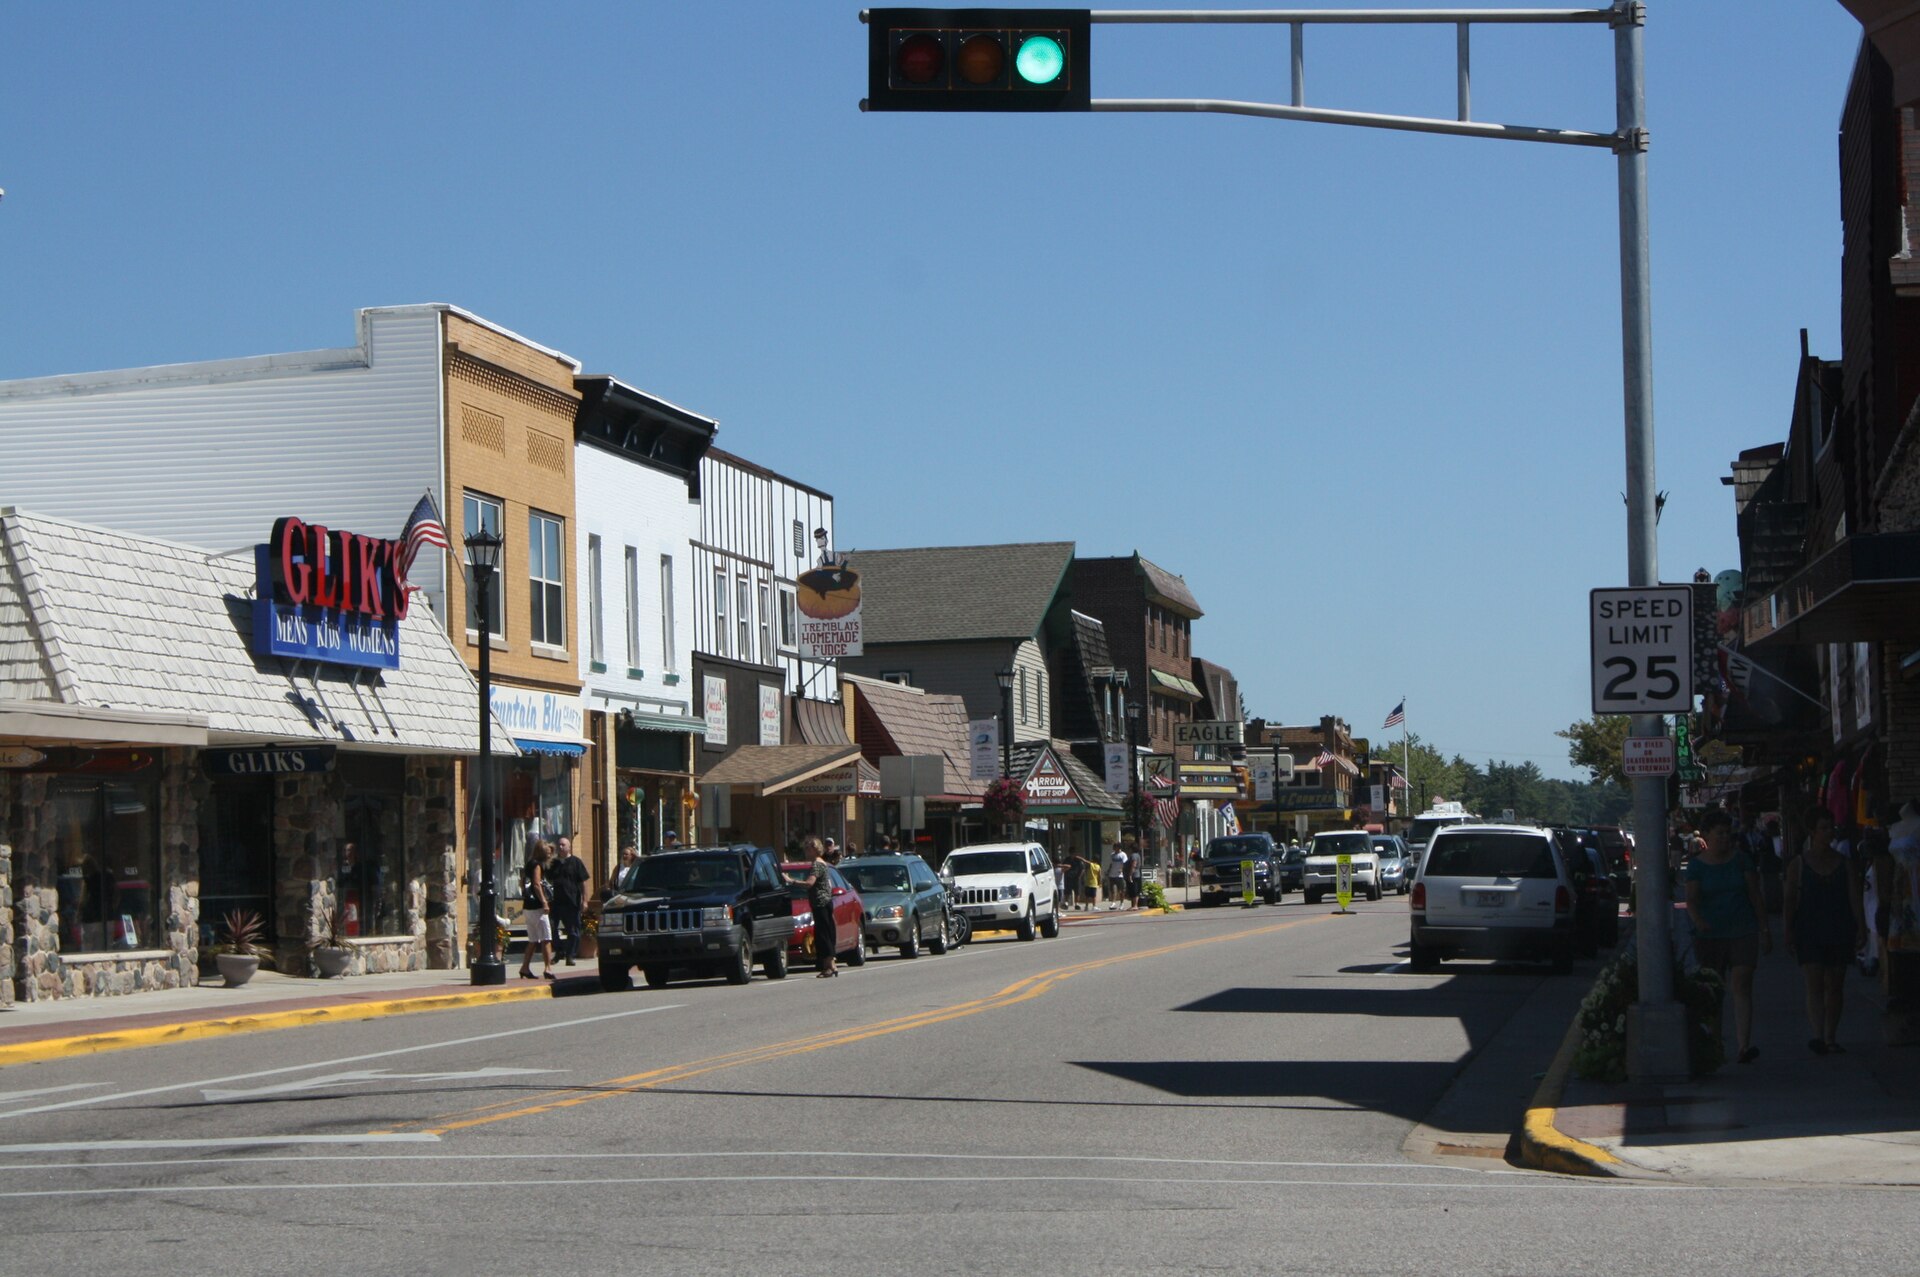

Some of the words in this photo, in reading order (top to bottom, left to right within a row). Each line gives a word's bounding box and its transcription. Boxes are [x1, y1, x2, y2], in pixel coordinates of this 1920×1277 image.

[281, 516, 409, 621] GLIK'S
[1599, 599, 1683, 619] SPEED
[276, 613, 308, 646] MENS
[349, 625, 396, 656] WOMENS
[801, 619, 859, 632] TREMBLAY'S
[1609, 625, 1673, 644] LIMIT
[801, 631, 859, 645] HOMEMADE
[812, 644, 848, 656] FUDGE
[1602, 655, 1680, 701] 25
[490, 686, 537, 730] ountain
[543, 694, 562, 733] Blu
[1177, 725, 1235, 741] EAGLE
[1677, 716, 1688, 766] ADING
[228, 751, 306, 773] GLIK'S
[795, 784, 833, 793] ACCESSORY
[836, 784, 853, 792] SHOP
